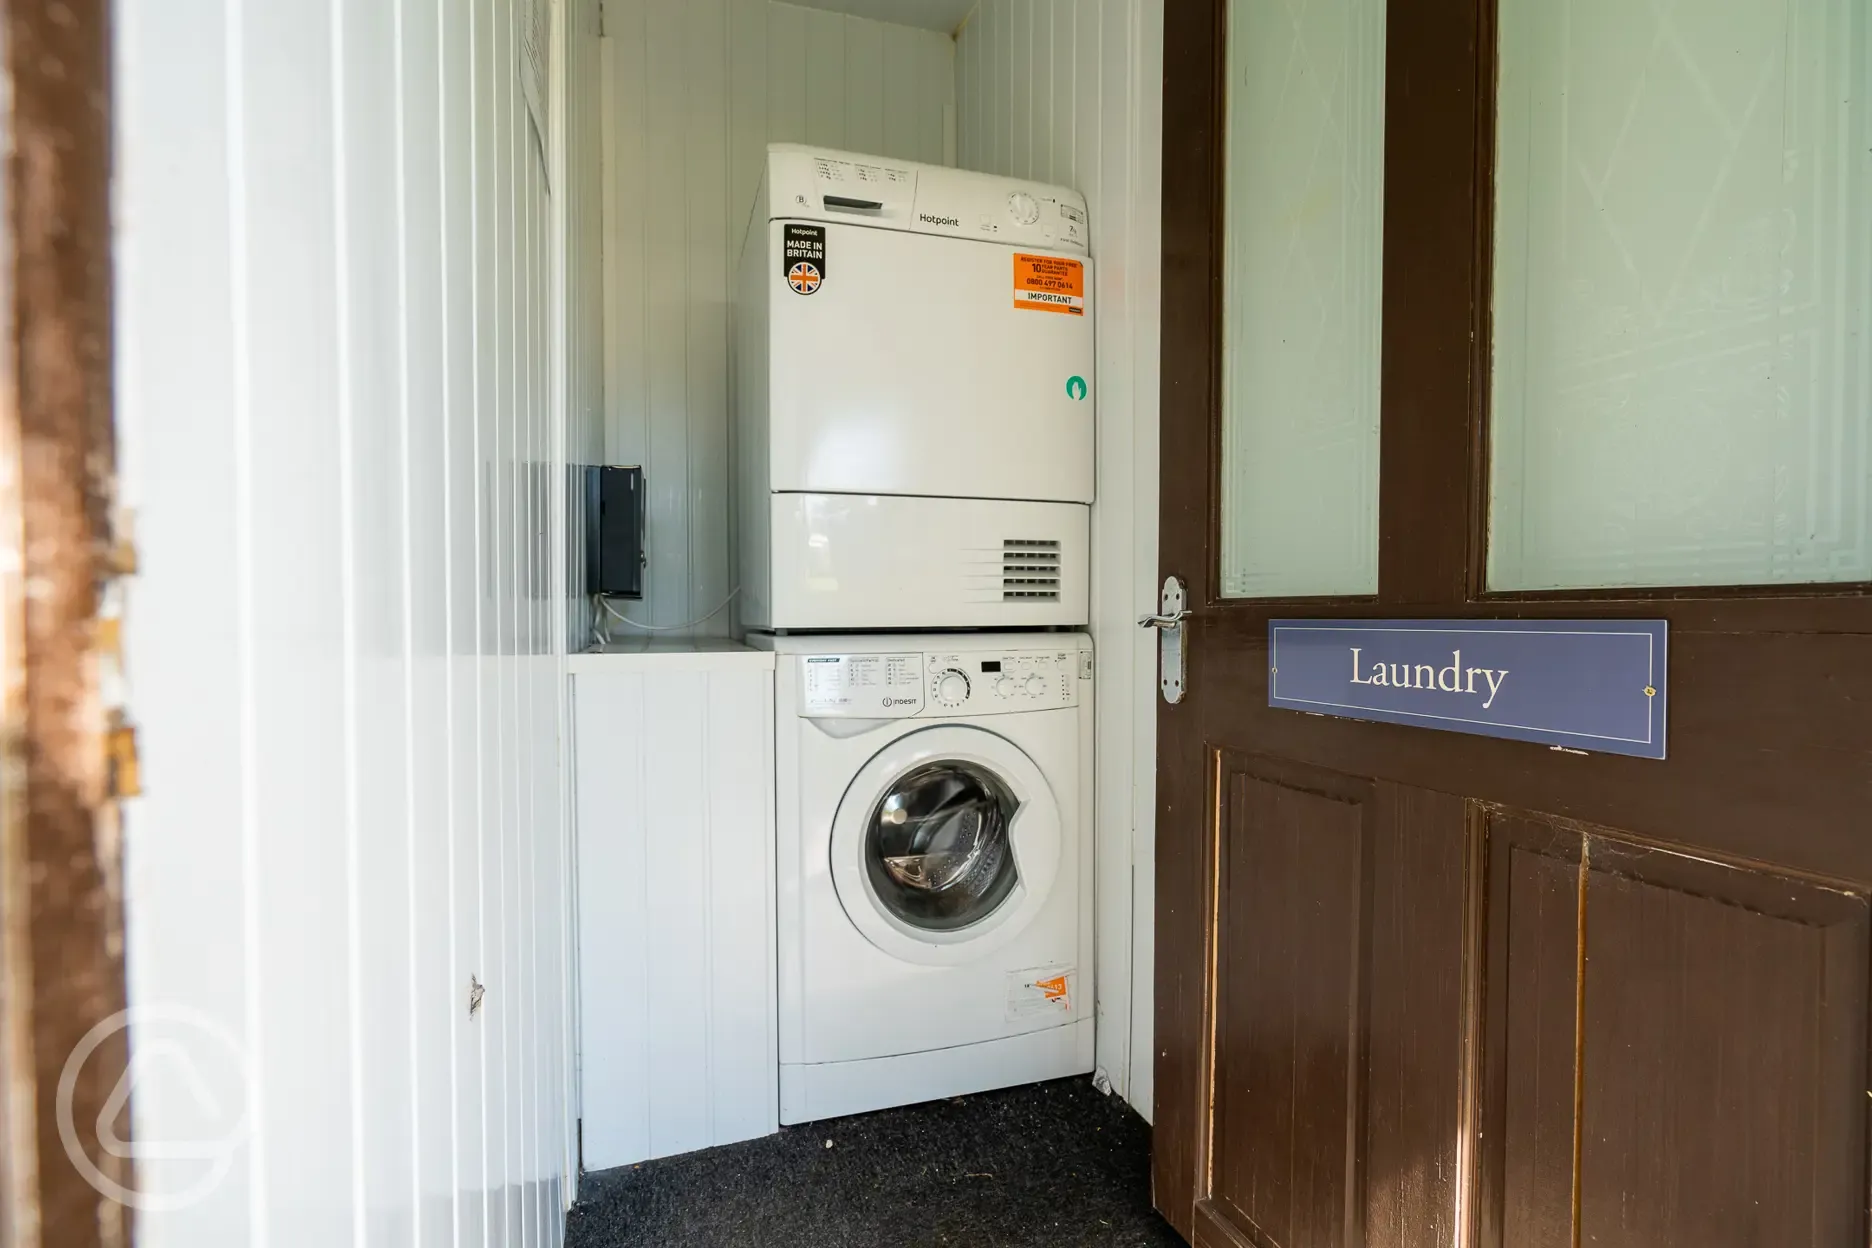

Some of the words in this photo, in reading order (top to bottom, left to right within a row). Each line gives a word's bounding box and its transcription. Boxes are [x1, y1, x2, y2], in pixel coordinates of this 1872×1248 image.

[919, 213, 959, 226] Hotpoint
[791, 228, 818, 236] Hotpoint
[787, 240, 812, 249] MADE
[813, 242, 822, 250] IN
[787, 249, 822, 259] BRITAIN
[1032, 264, 1041, 272] 10
[1028, 292, 1072, 304] IMPORTANT
[1349, 647, 1509, 709] Laundry
